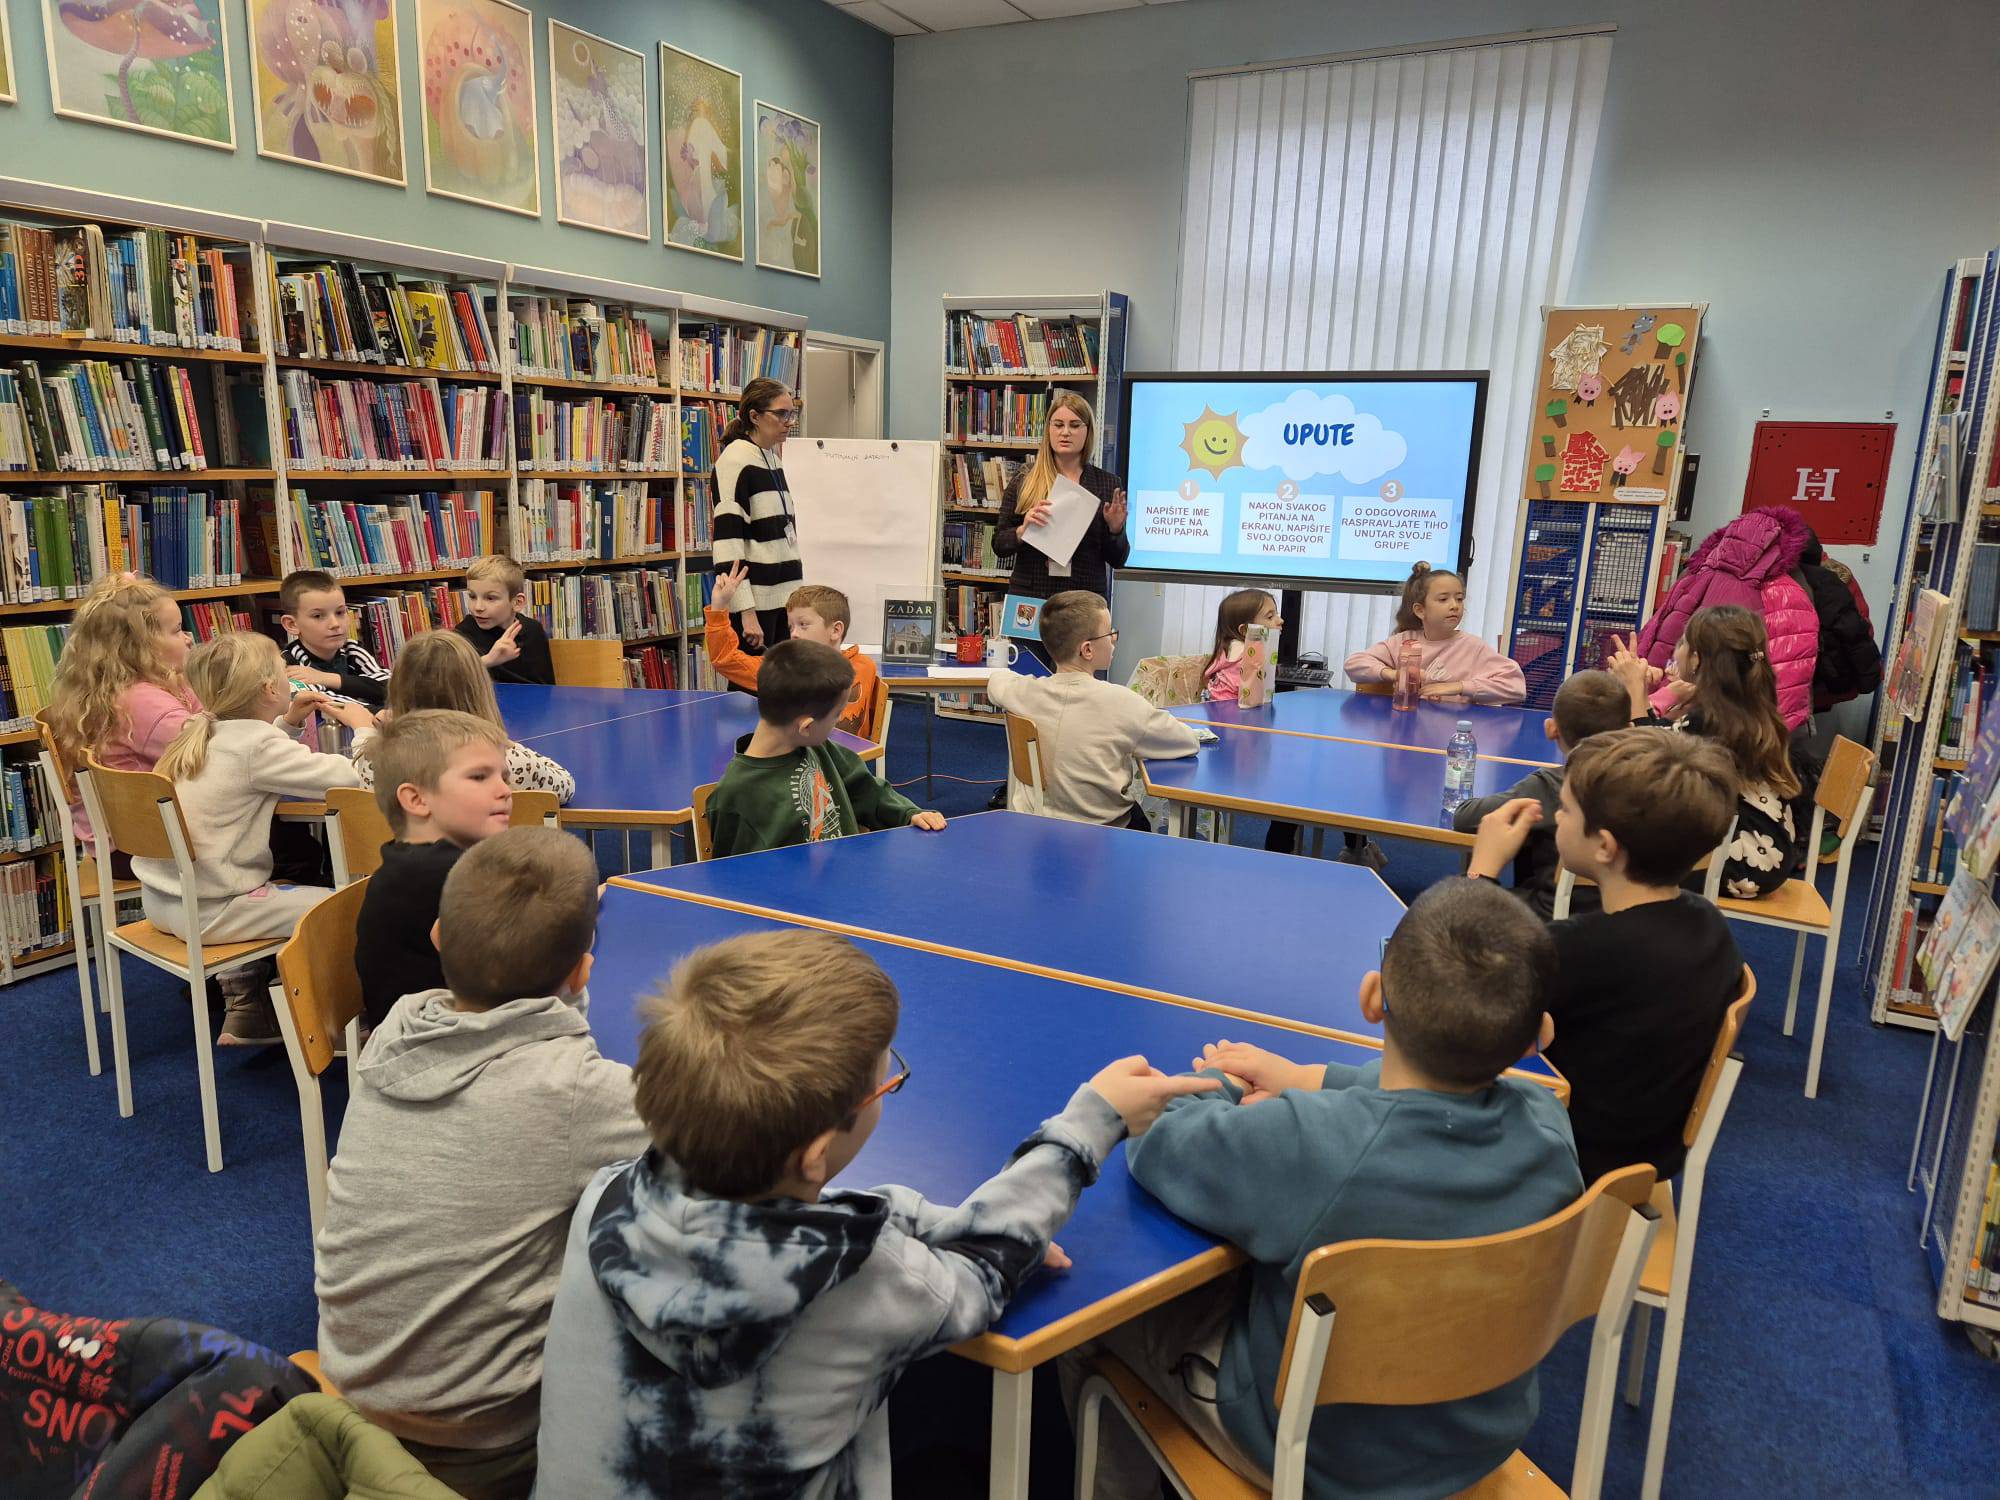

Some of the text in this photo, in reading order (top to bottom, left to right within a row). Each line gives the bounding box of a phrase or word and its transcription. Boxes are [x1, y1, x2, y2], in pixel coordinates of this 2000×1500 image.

[1284, 423, 1355, 446] UPUTE
[1185, 481, 1191, 496] 1
[1792, 468, 1840, 501] H
[1281, 484, 1294, 499] 2
[1384, 482, 1397, 498] 3
[1146, 505, 1210, 516] NAPIŠITE IME
[1248, 502, 1327, 511] NAKON SVAKOG
[1259, 512, 1298, 521] PITANJA
[1355, 508, 1437, 518] O ODGOVORIMA
[1152, 516, 1203, 526] GRUPE NA
[1341, 518, 1448, 530] RASPRAVLJATE TIHO
[1145, 527, 1209, 537] VRHU PAPIRA
[1287, 523, 1331, 533] NAPIŠITE
[1247, 532, 1324, 543] SVOJ ODGOVOR
[1354, 529, 1432, 540] UNUTAR SVOJE
[1262, 544, 1306, 553] NA PAPIR
[1374, 540, 1410, 550] GRUPE
[888, 605, 933, 615] ZADAR
